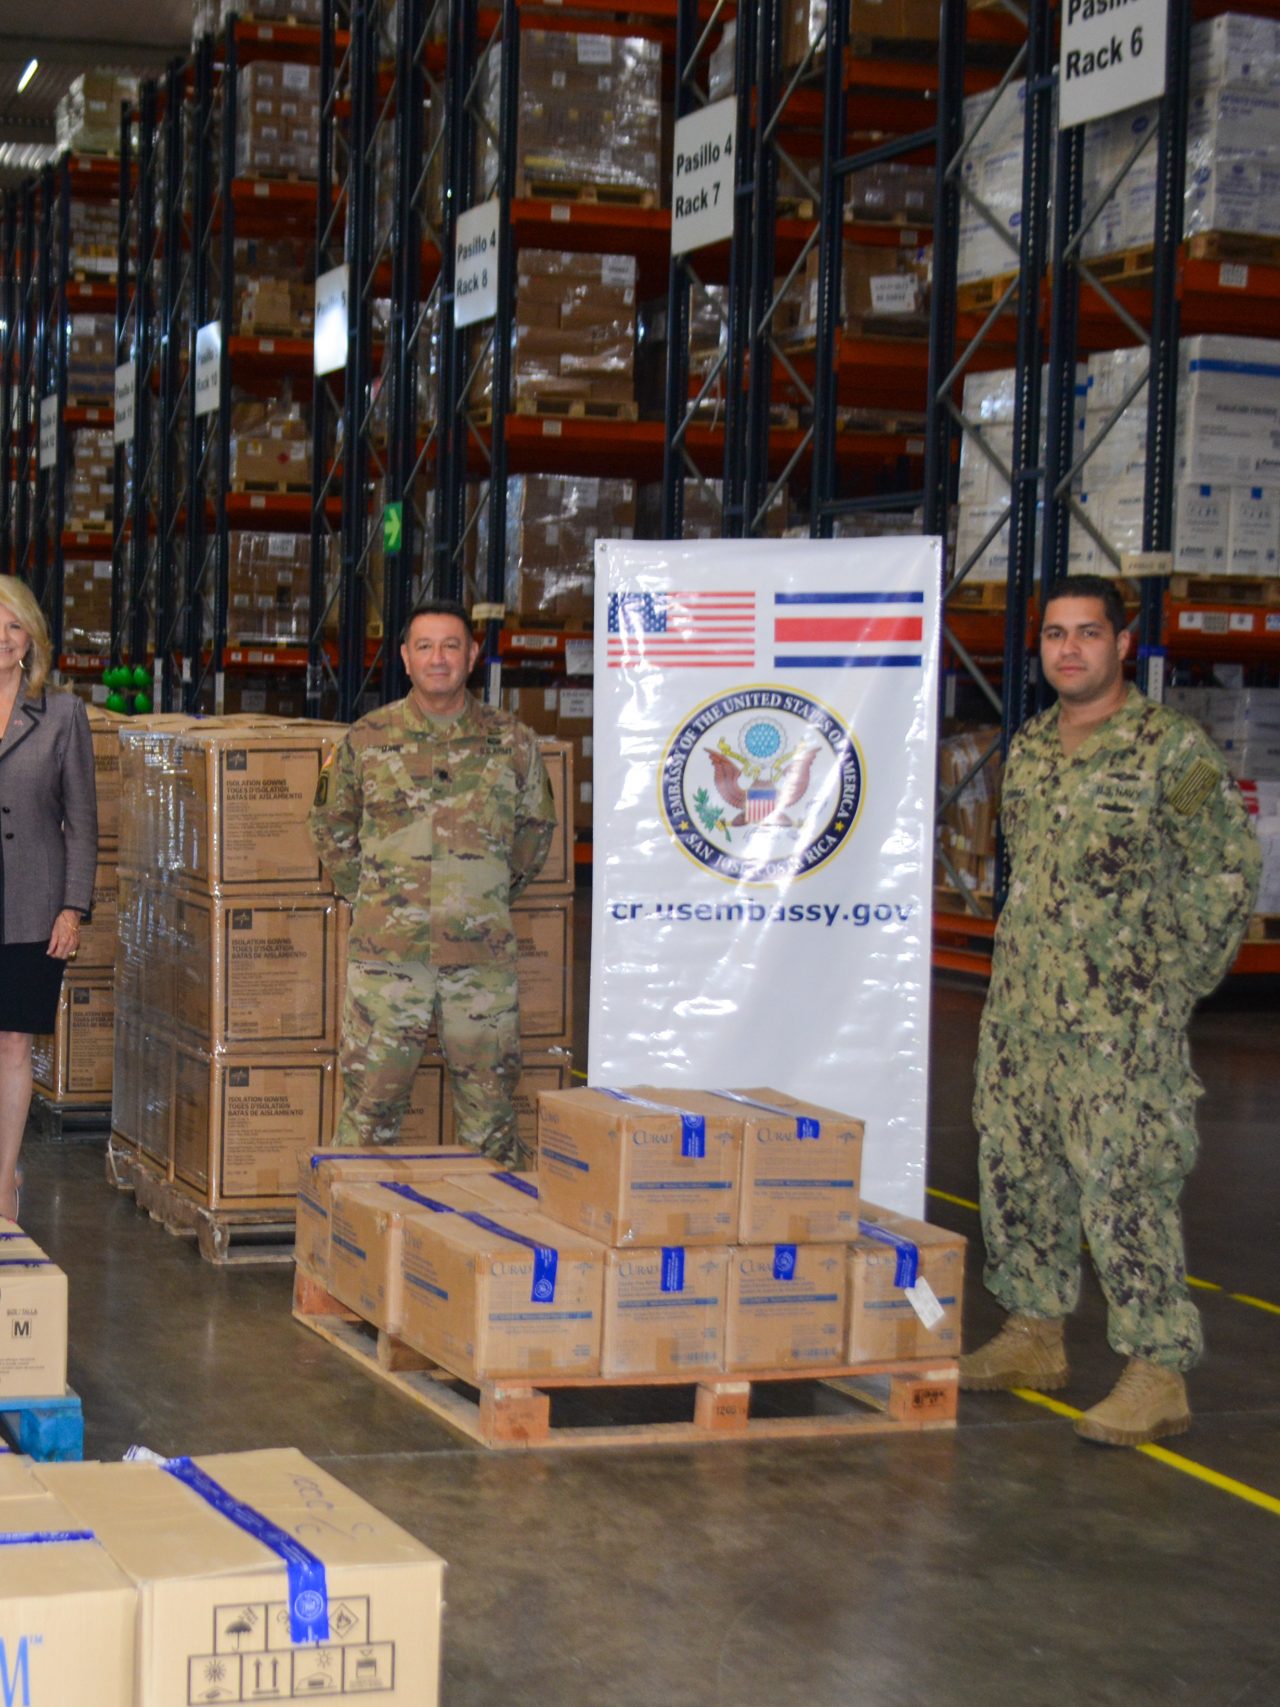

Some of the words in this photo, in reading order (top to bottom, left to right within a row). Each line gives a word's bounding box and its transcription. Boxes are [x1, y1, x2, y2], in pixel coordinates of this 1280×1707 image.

[1066, 35, 1122, 81] Rack
[1130, 26, 1144, 57] 6
[676, 141, 720, 177] Pasillo
[724, 132, 733, 156] 4
[675, 186, 708, 219] Rack
[713, 182, 721, 206] 7
[457, 234, 487, 262] Pasillo
[489, 229, 496, 248] 4
[456, 274, 479, 297] Rack
[481, 268, 488, 288] 8
[669, 746, 688, 818] EMBASSY
[679, 731, 701, 748] OF
[692, 704, 724, 732] THE
[721, 692, 782, 712] UNITED
[784, 694, 832, 732] STATES
[226, 779, 261, 787] ISOLATION
[262, 779, 287, 787] GOWNS
[685, 833, 713, 860] SAN
[805, 834, 838, 863] RICA
[14, 1321, 29, 1337] M
